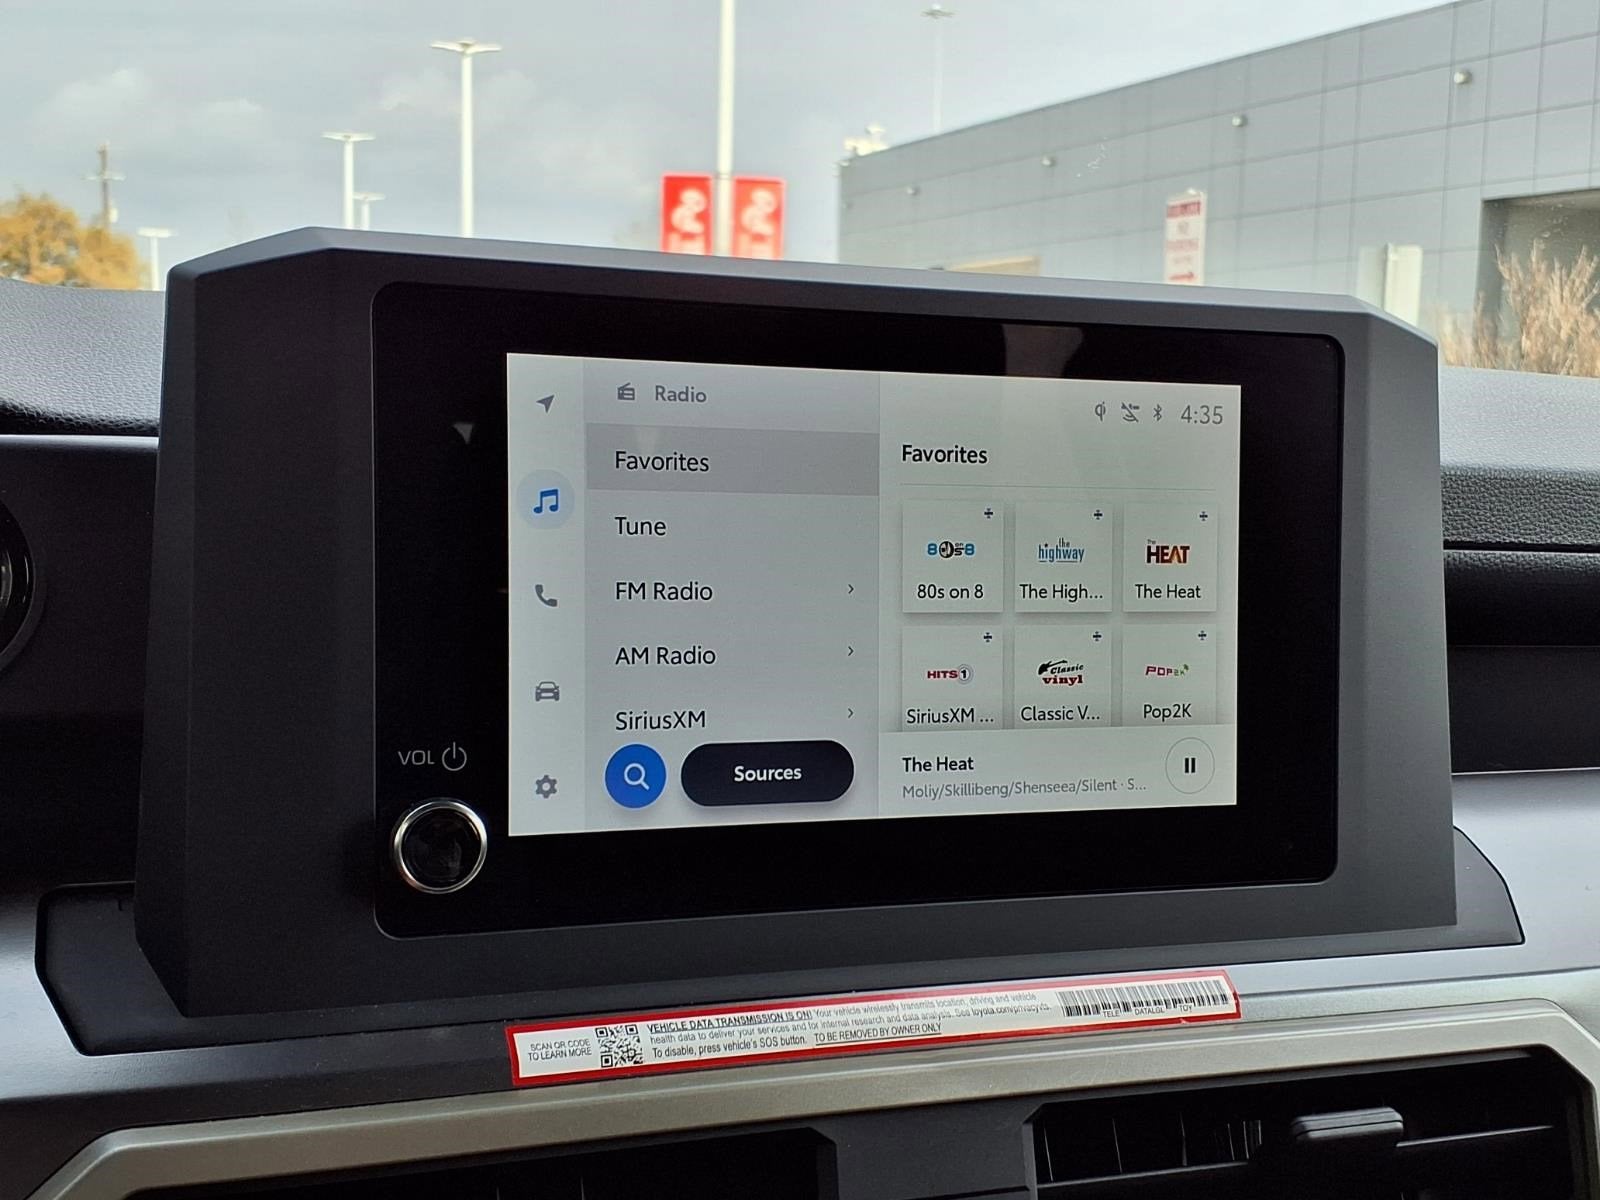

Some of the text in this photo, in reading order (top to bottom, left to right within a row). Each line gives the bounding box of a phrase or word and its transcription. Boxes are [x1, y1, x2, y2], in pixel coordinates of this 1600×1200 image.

[654, 385, 707, 403] Radio
[1181, 405, 1224, 425] 4:35
[615, 451, 709, 473] Favorites
[902, 444, 988, 464] Favorites
[615, 516, 667, 536] Tune
[1058, 537, 1071, 548] the
[1038, 543, 1085, 563] highway
[1146, 545, 1190, 563] HEAT
[615, 581, 713, 601] FM Radio
[917, 583, 984, 599] 80s on 8
[1019, 583, 1048, 599] The
[1135, 583, 1201, 599] The Heat
[615, 646, 716, 665] AM Radio
[927, 670, 958, 679] HITS
[1049, 663, 1085, 675] Classic
[1042, 674, 1083, 686] vinyl
[615, 710, 706, 731] SiriusXM
[907, 707, 975, 724] SiriusXM
[1020, 705, 1074, 721] Classic
[1144, 703, 1192, 723] Pop2K
[397, 749, 435, 765] VOL
[902, 756, 975, 773] The Heat
[733, 765, 802, 782] Sources
[1103, 1009, 1120, 1018] TELE
[647, 1020, 688, 1034] VEHICLE
[689, 1018, 714, 1030] DATA
[715, 1012, 784, 1028] TRANSMISSION
[785, 1011, 795, 1021] IS
[530, 1041, 553, 1051] SCAN
[568, 1038, 591, 1048] CODE
[650, 1033, 676, 1045] health
[678, 1031, 696, 1042] data
[698, 1031, 707, 1041] to
[709, 1028, 736, 1040] deliver
[737, 1027, 755, 1039] your
[652, 1047, 663, 1058] To
[664, 1045, 697, 1057] disable,
[699, 1043, 721, 1056] press
[723, 1038, 758, 1050] vehicle's
[759, 1036, 778, 1048] SOS
[814, 1032, 825, 1042] TO
[827, 1030, 838, 1041] BE
[839, 1027, 879, 1040] REMOVED
[879, 1026, 890, 1037] BY
[891, 1024, 920, 1036] OWNER
[921, 1022, 942, 1033] ONLY
[528, 1047, 592, 1061] TO LEARN MORE
